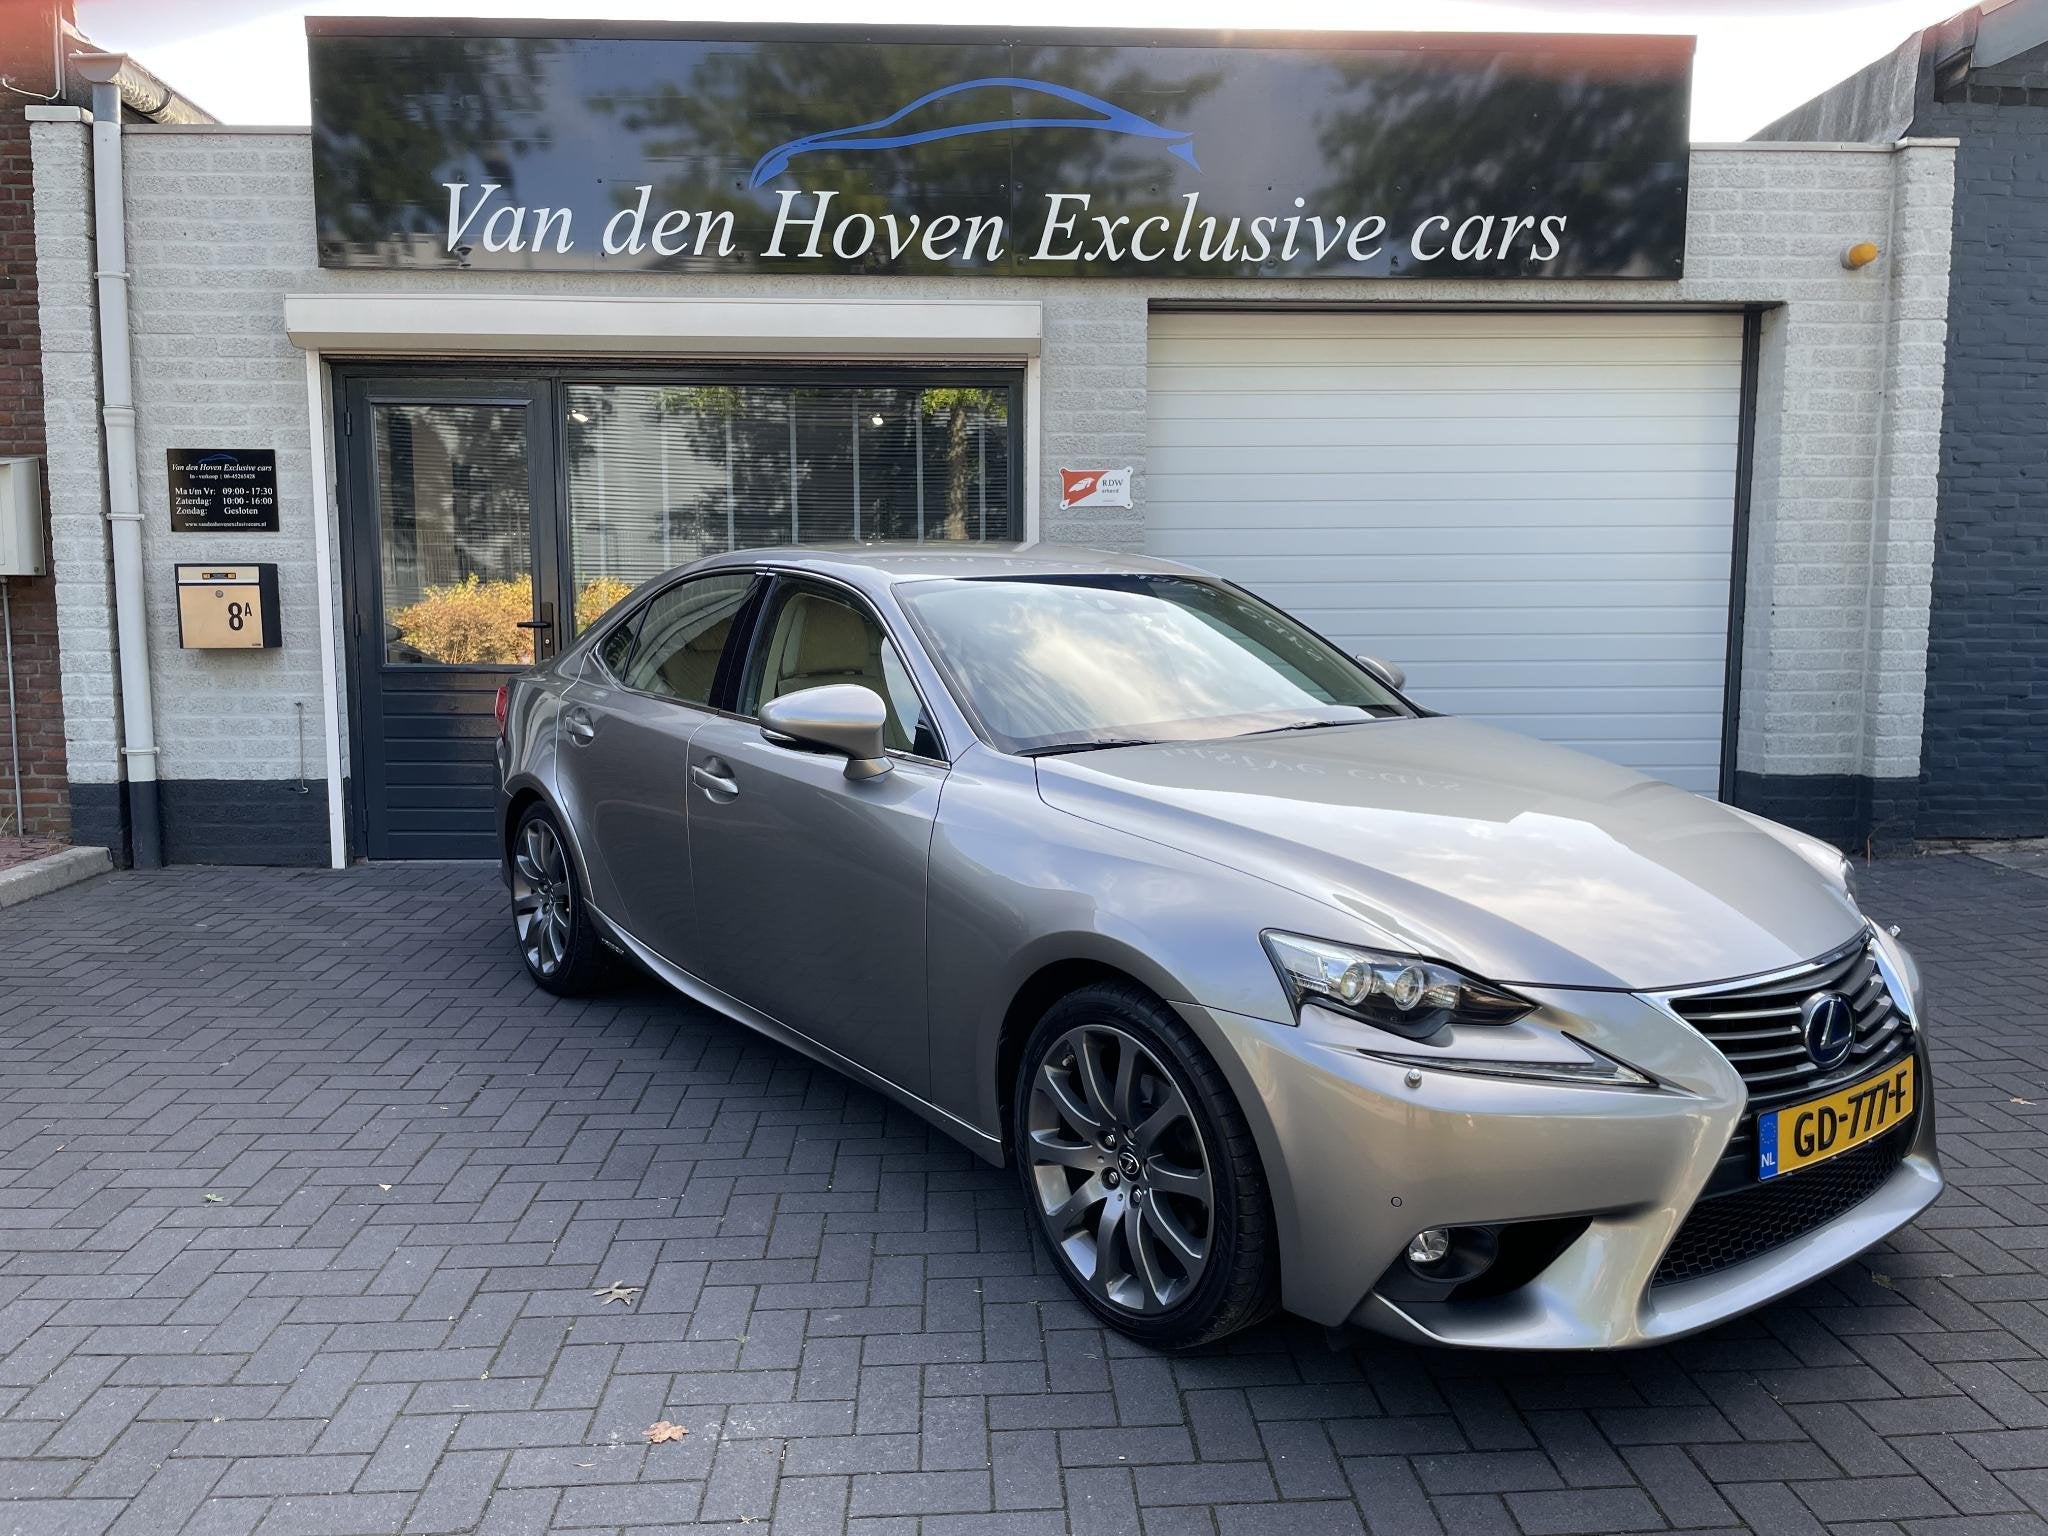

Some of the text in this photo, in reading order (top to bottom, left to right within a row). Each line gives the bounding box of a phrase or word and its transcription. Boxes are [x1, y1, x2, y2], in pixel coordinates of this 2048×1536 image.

[442, 182, 1567, 262] Van den Hoven Exclusive cars
[172, 463, 184, 471] Van
[185, 463, 198, 471] den
[200, 463, 222, 471] Hoven
[224, 463, 256, 471] Exclusive
[1102, 479, 1124, 487] RDW
[175, 487, 188, 495] Ma
[189, 487, 202, 495] t/m
[222, 487, 245, 495] 09:00
[251, 487, 273, 495] 17:30
[175, 497, 212, 506] Zaterdag:
[223, 497, 244, 505] 10:00
[251, 497, 273, 505] 16:00
[176, 507, 258, 516] Zondag: Gesloten
[1794, 1070, 1908, 1158] GD-777-F
[1761, 1153, 1776, 1168] NL
